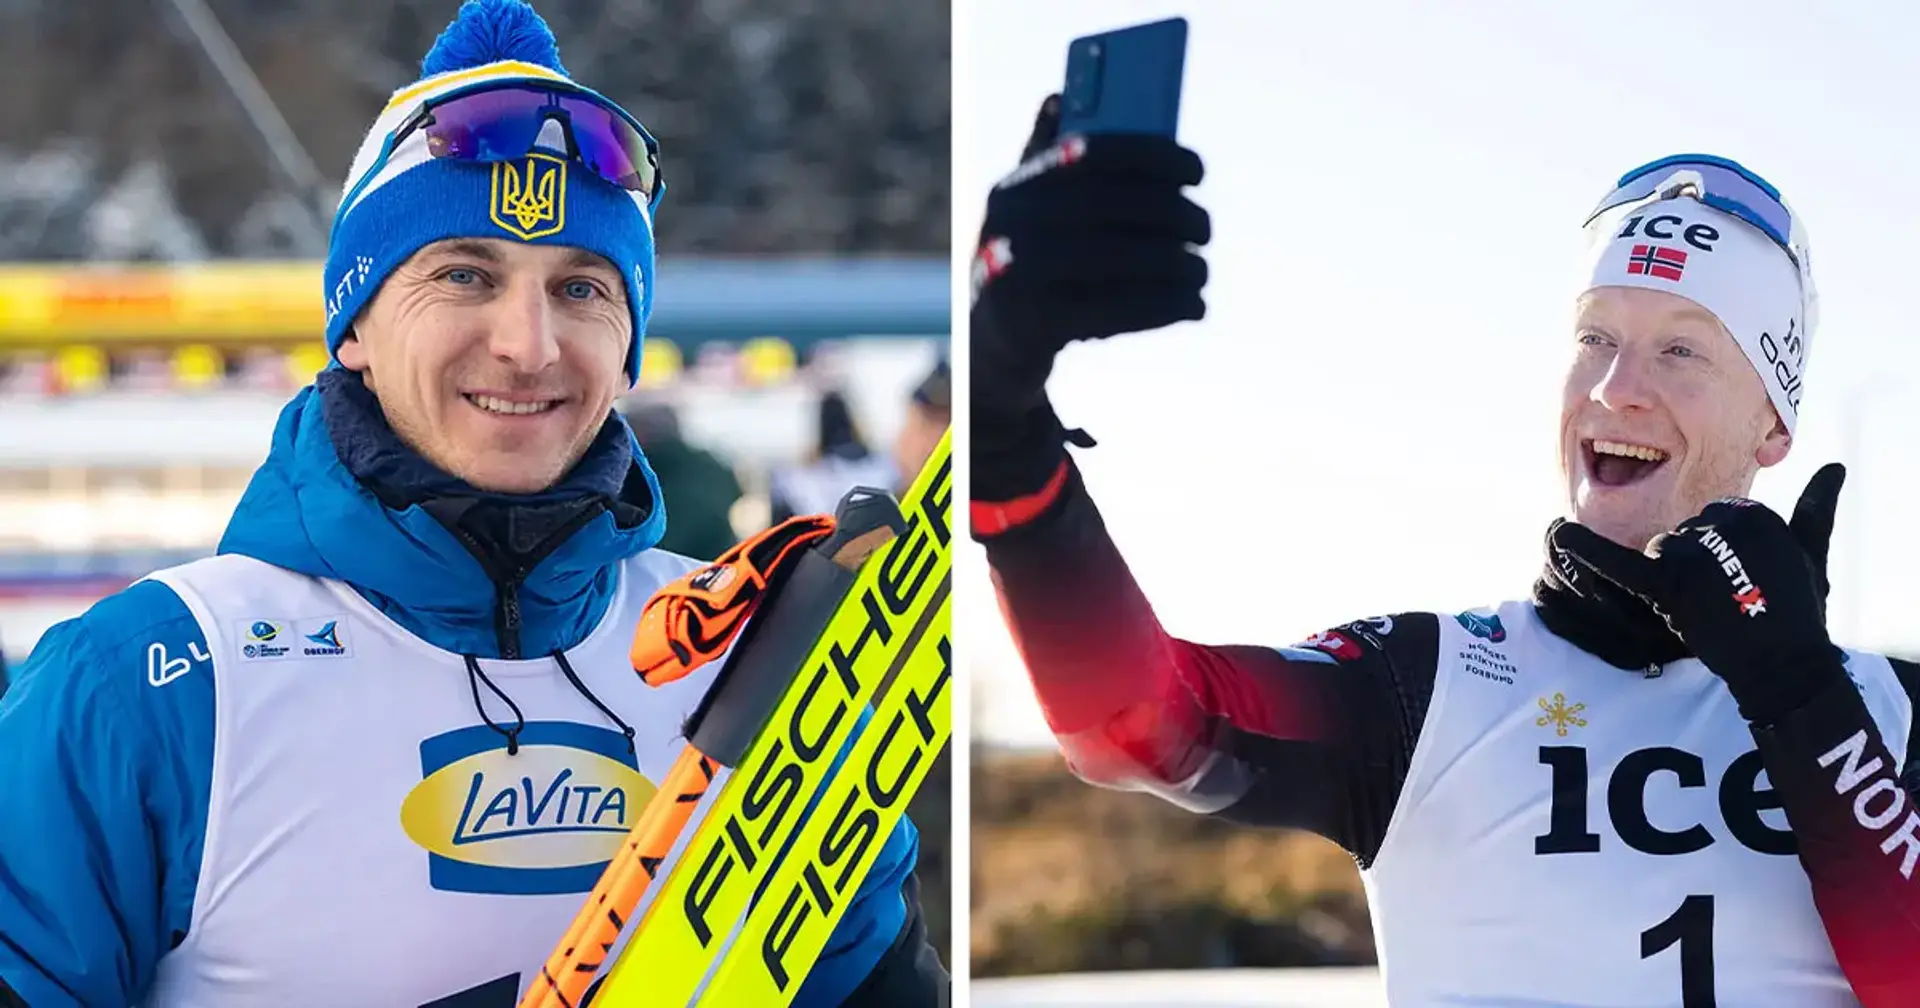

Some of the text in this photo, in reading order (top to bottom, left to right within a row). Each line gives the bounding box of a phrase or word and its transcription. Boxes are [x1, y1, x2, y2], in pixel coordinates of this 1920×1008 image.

[1618, 215, 1720, 252] ice
[1535, 745, 1800, 856] ice
[1640, 895, 1717, 1008] 1
